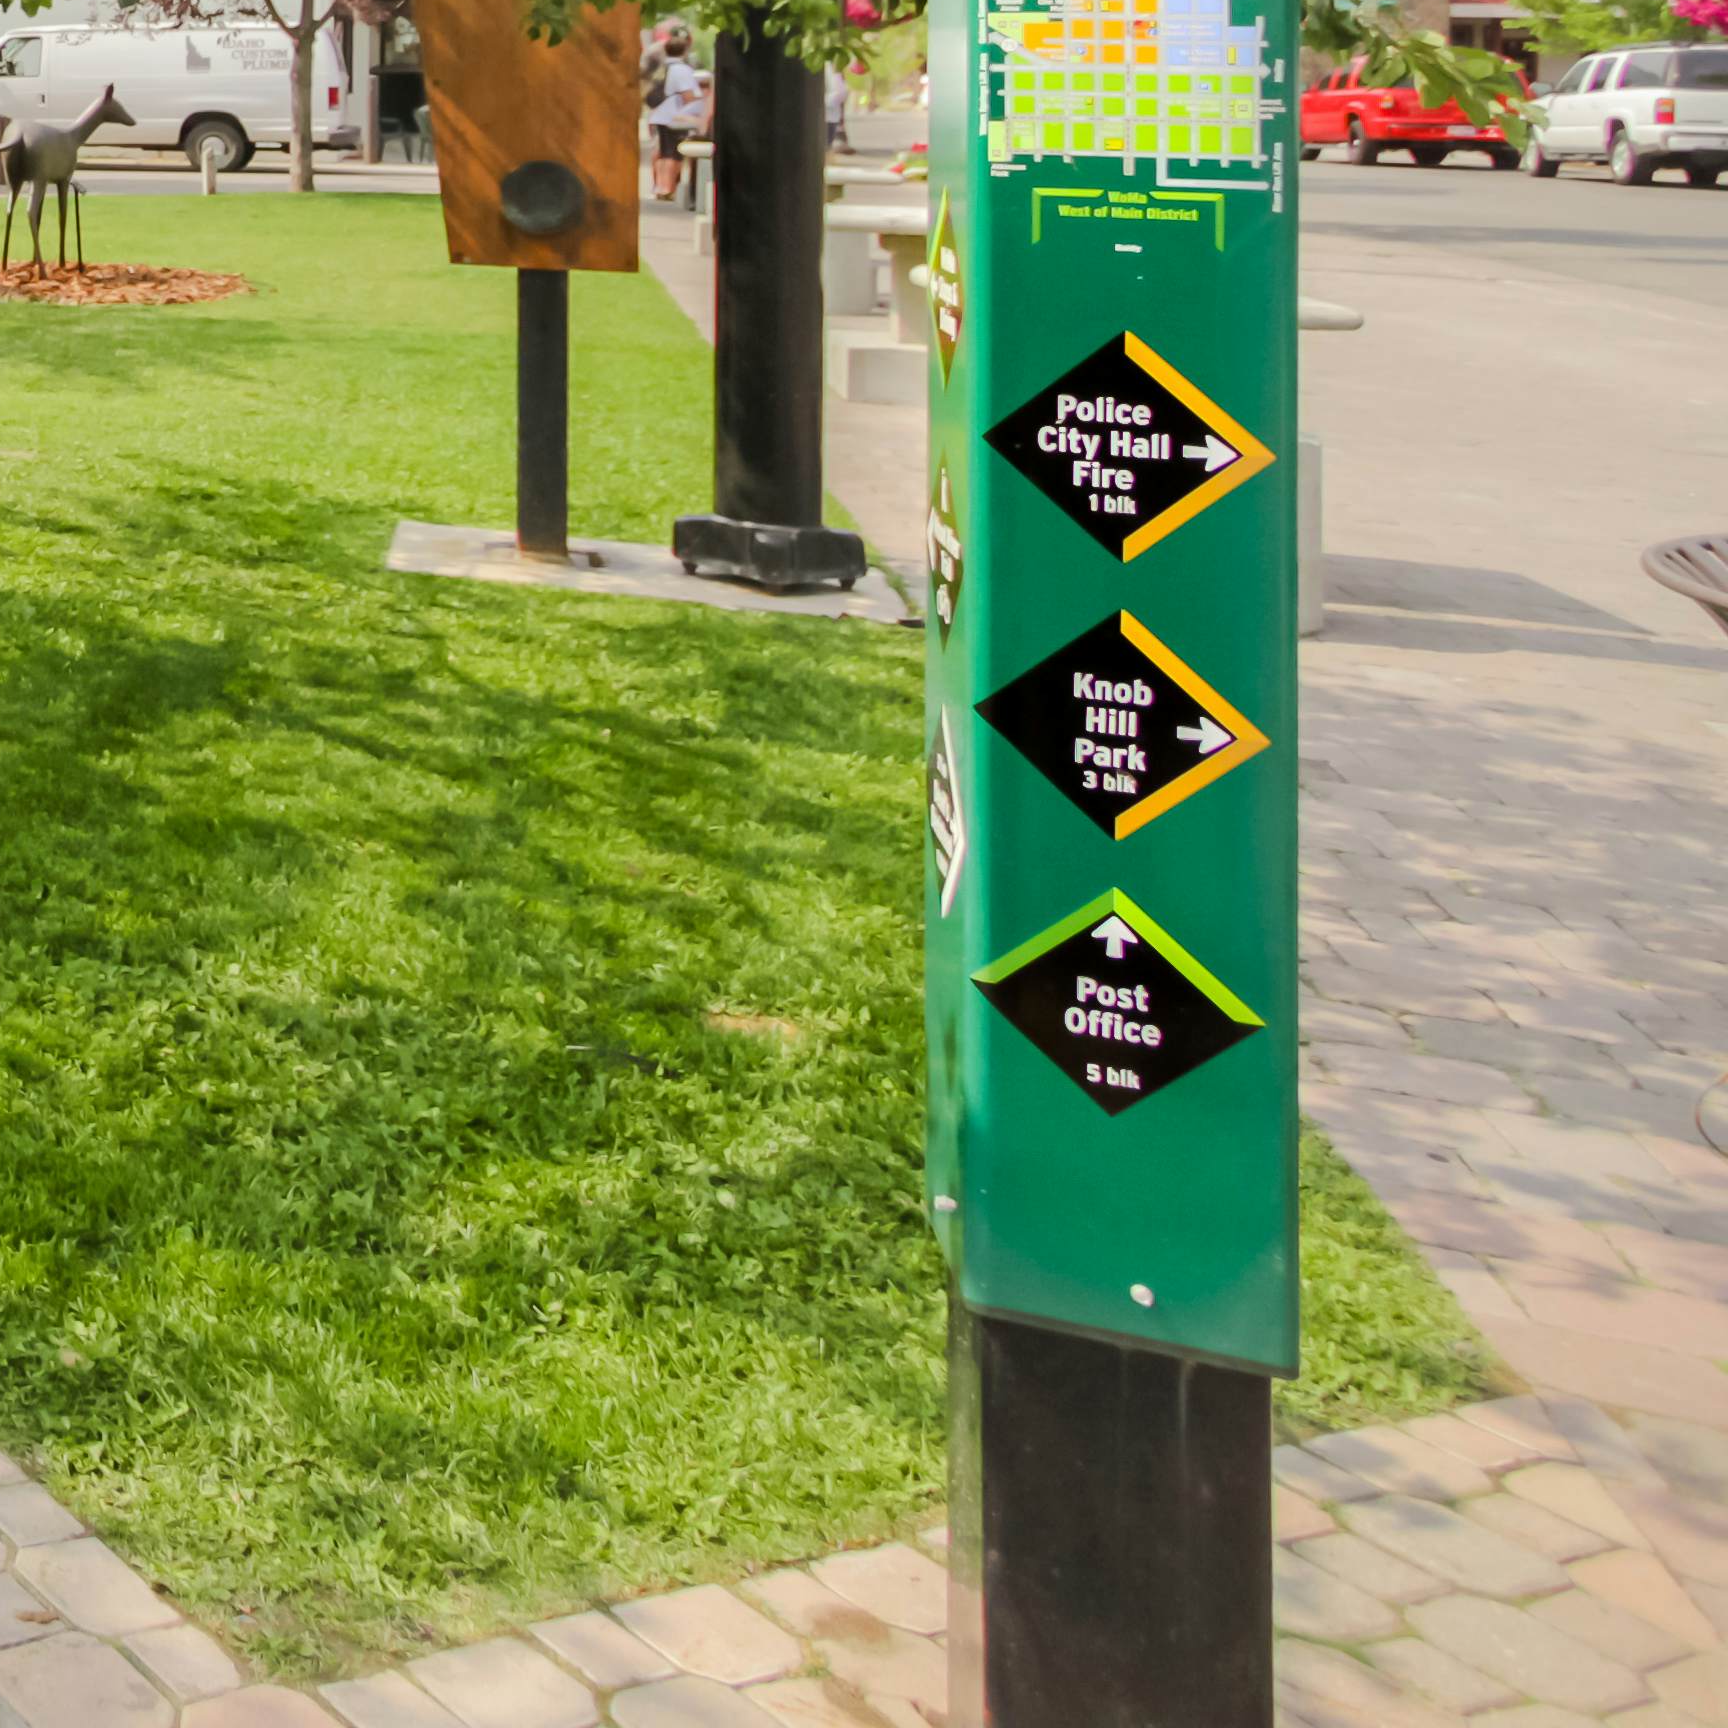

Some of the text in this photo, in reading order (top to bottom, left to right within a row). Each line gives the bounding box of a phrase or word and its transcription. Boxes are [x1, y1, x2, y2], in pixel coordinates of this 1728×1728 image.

[231, 49, 289, 60] CUSTOM
[242, 59, 291, 71] PLUMB
[1057, 204, 1092, 218] West
[1093, 205, 1109, 218] of
[1146, 207, 1200, 222] District
[1056, 393, 1153, 426] Police
[1037, 425, 1172, 461] City Hall
[1072, 460, 1136, 491] Fire
[1089, 493, 1137, 515] 1 blk
[1073, 671, 1154, 707] Knob
[1085, 706, 1139, 738] Hill
[1074, 737, 1147, 772] Park
[1082, 770, 1138, 795] 3 blk
[1076, 975, 1150, 1013] Post
[1064, 1006, 1163, 1047] Office
[1086, 1063, 1142, 1091] 5 blk
